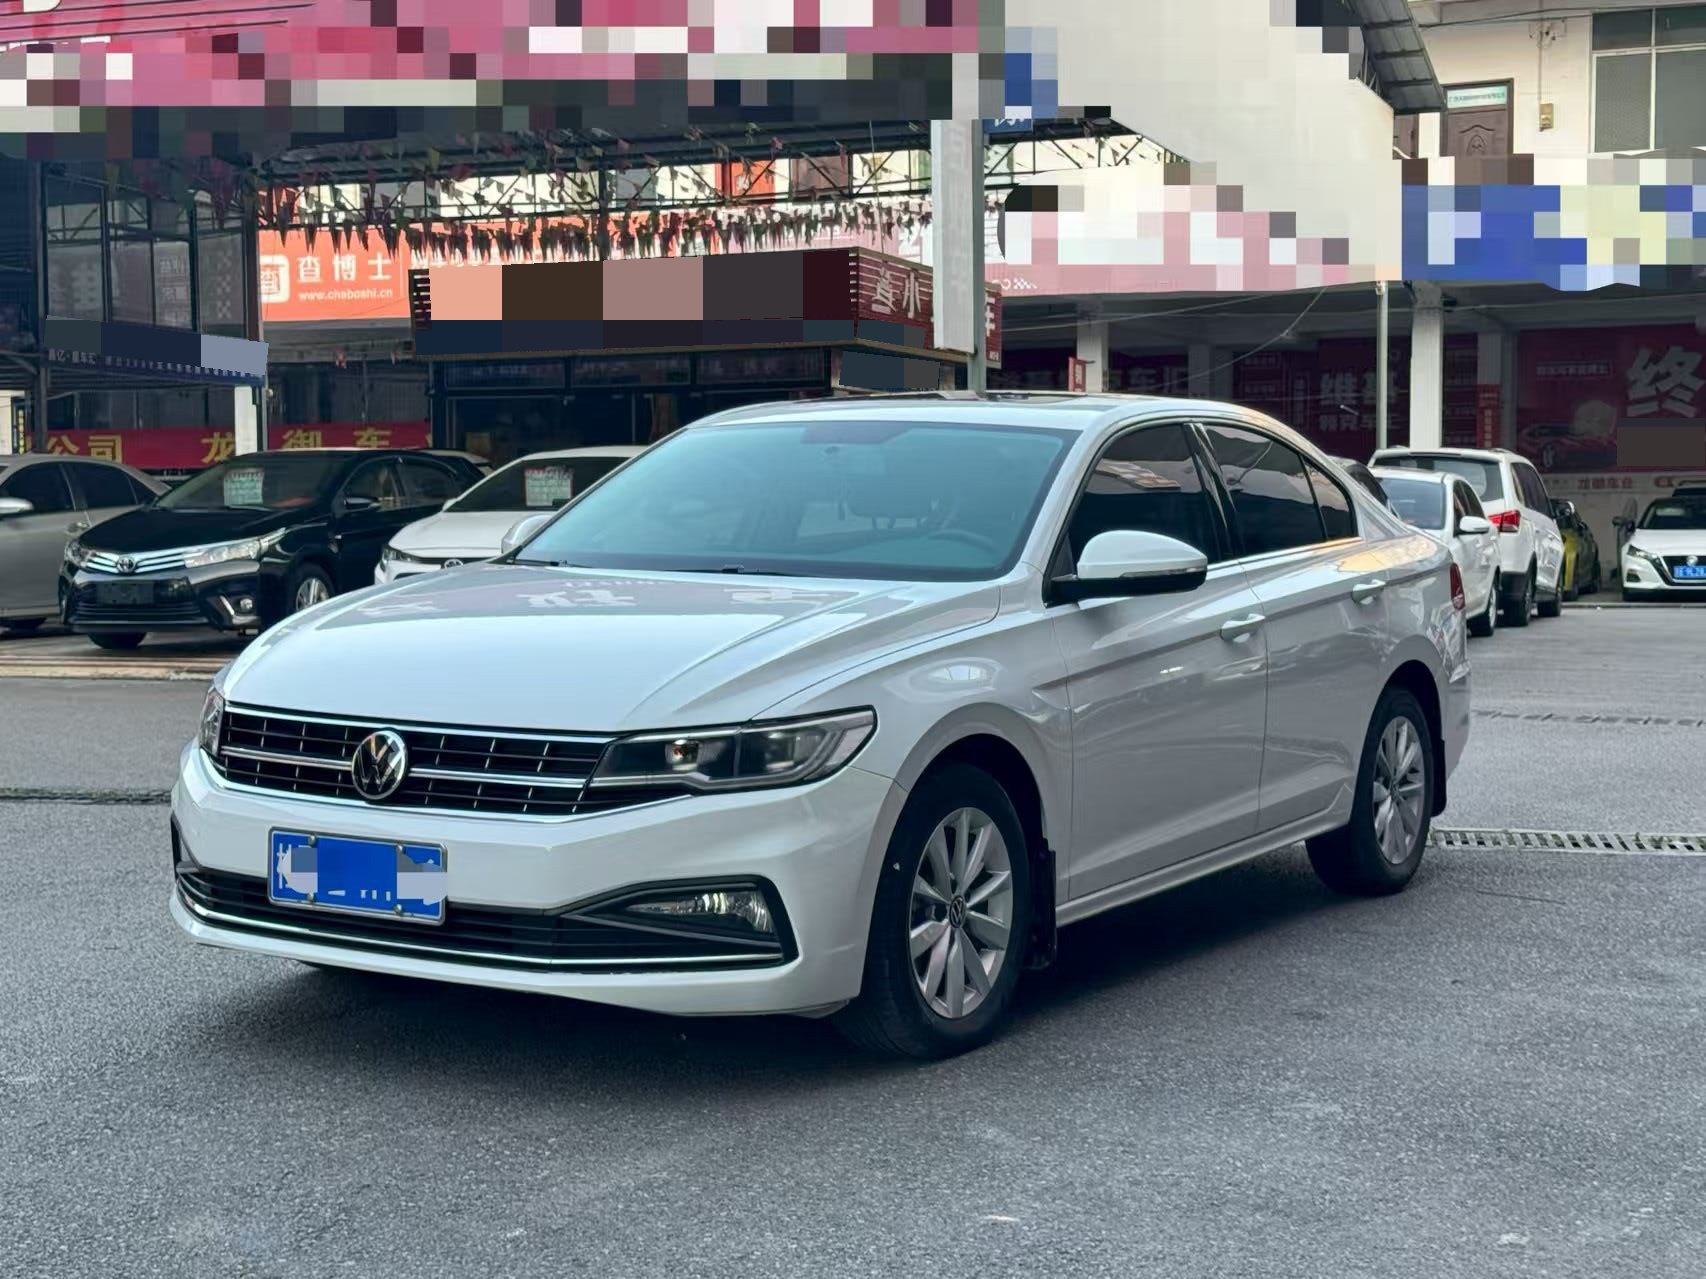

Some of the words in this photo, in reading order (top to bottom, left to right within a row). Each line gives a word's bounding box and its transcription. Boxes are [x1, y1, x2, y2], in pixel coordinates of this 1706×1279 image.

[298, 252, 392, 282] 查博士
[299, 288, 393, 300] www.chaboshi.cn
[1625, 346, 1705, 418] 终
[48, 433, 123, 464] 公司
